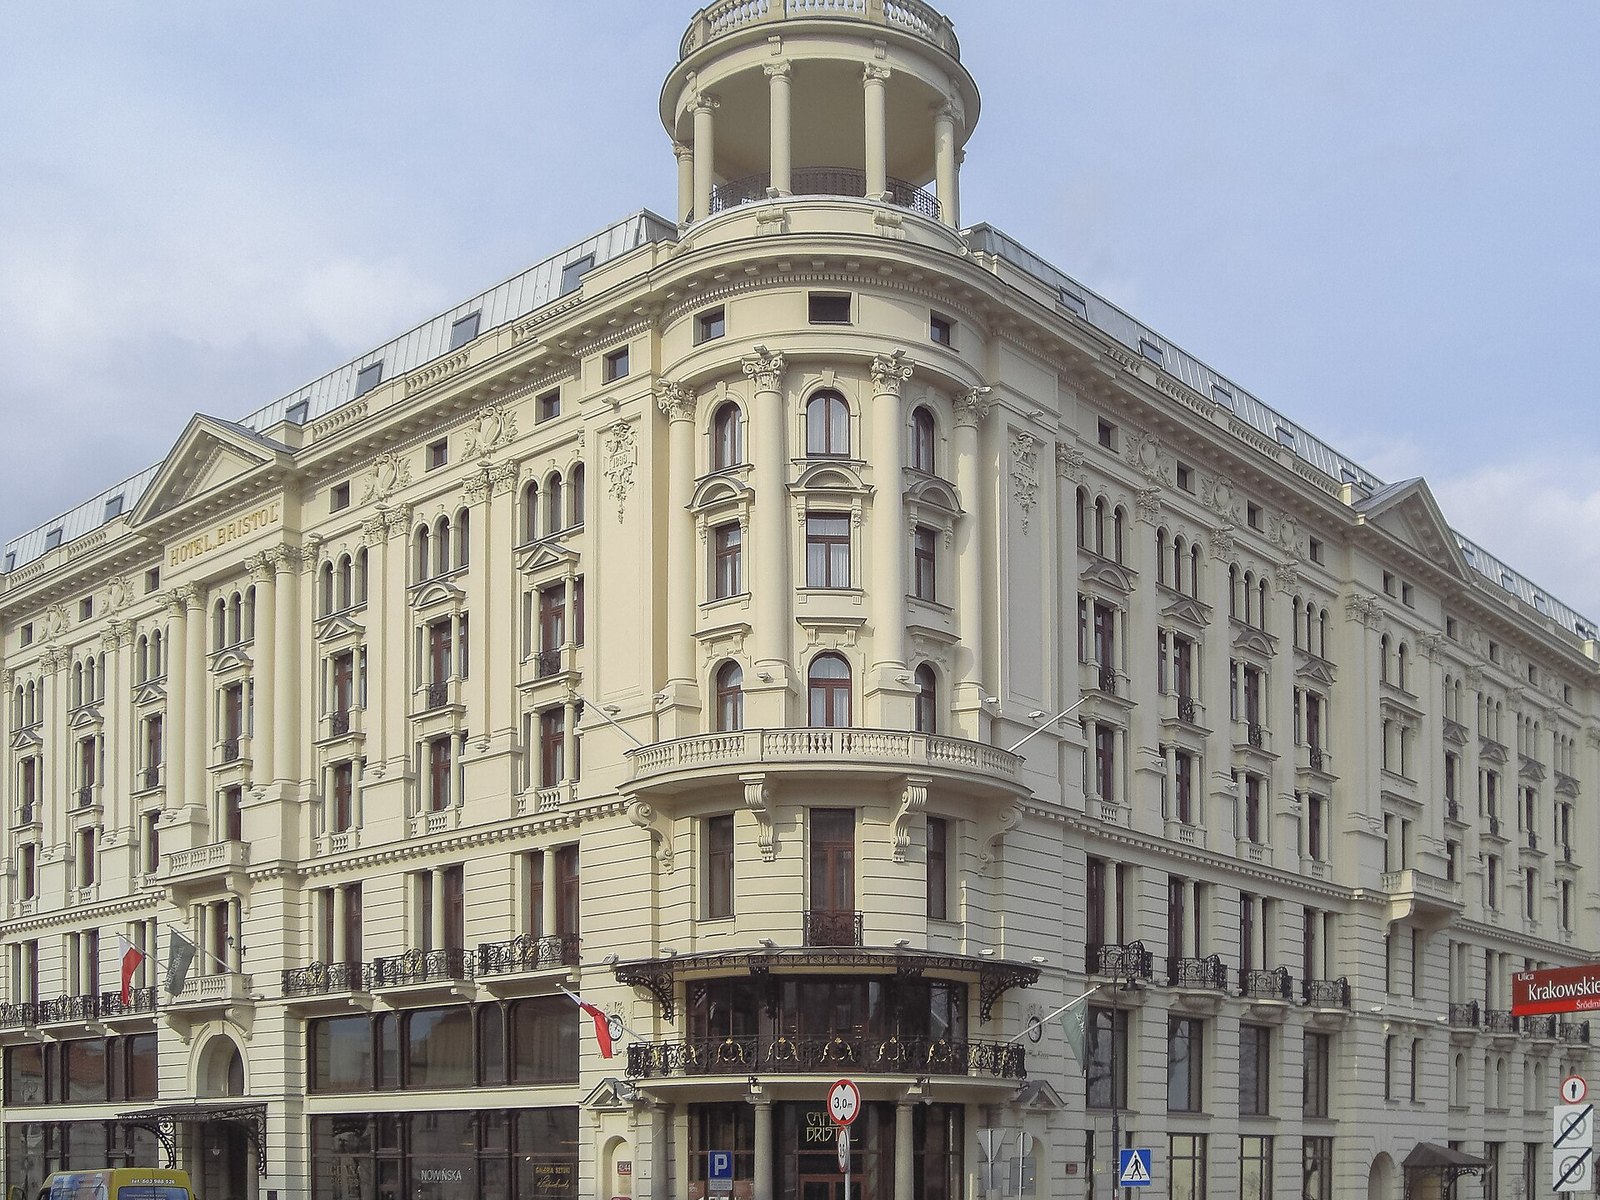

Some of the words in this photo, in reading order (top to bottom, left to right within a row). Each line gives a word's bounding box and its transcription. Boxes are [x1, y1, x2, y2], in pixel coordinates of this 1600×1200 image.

[170, 534, 212, 567] HOTEL
[1518, 973, 1534, 981] Ulica
[1529, 976, 1600, 1000] Krakowskie
[806, 1127, 858, 1141] BRIST
[714, 1154, 728, 1175] P
[421, 1168, 462, 1181] NOWIŃSKA
